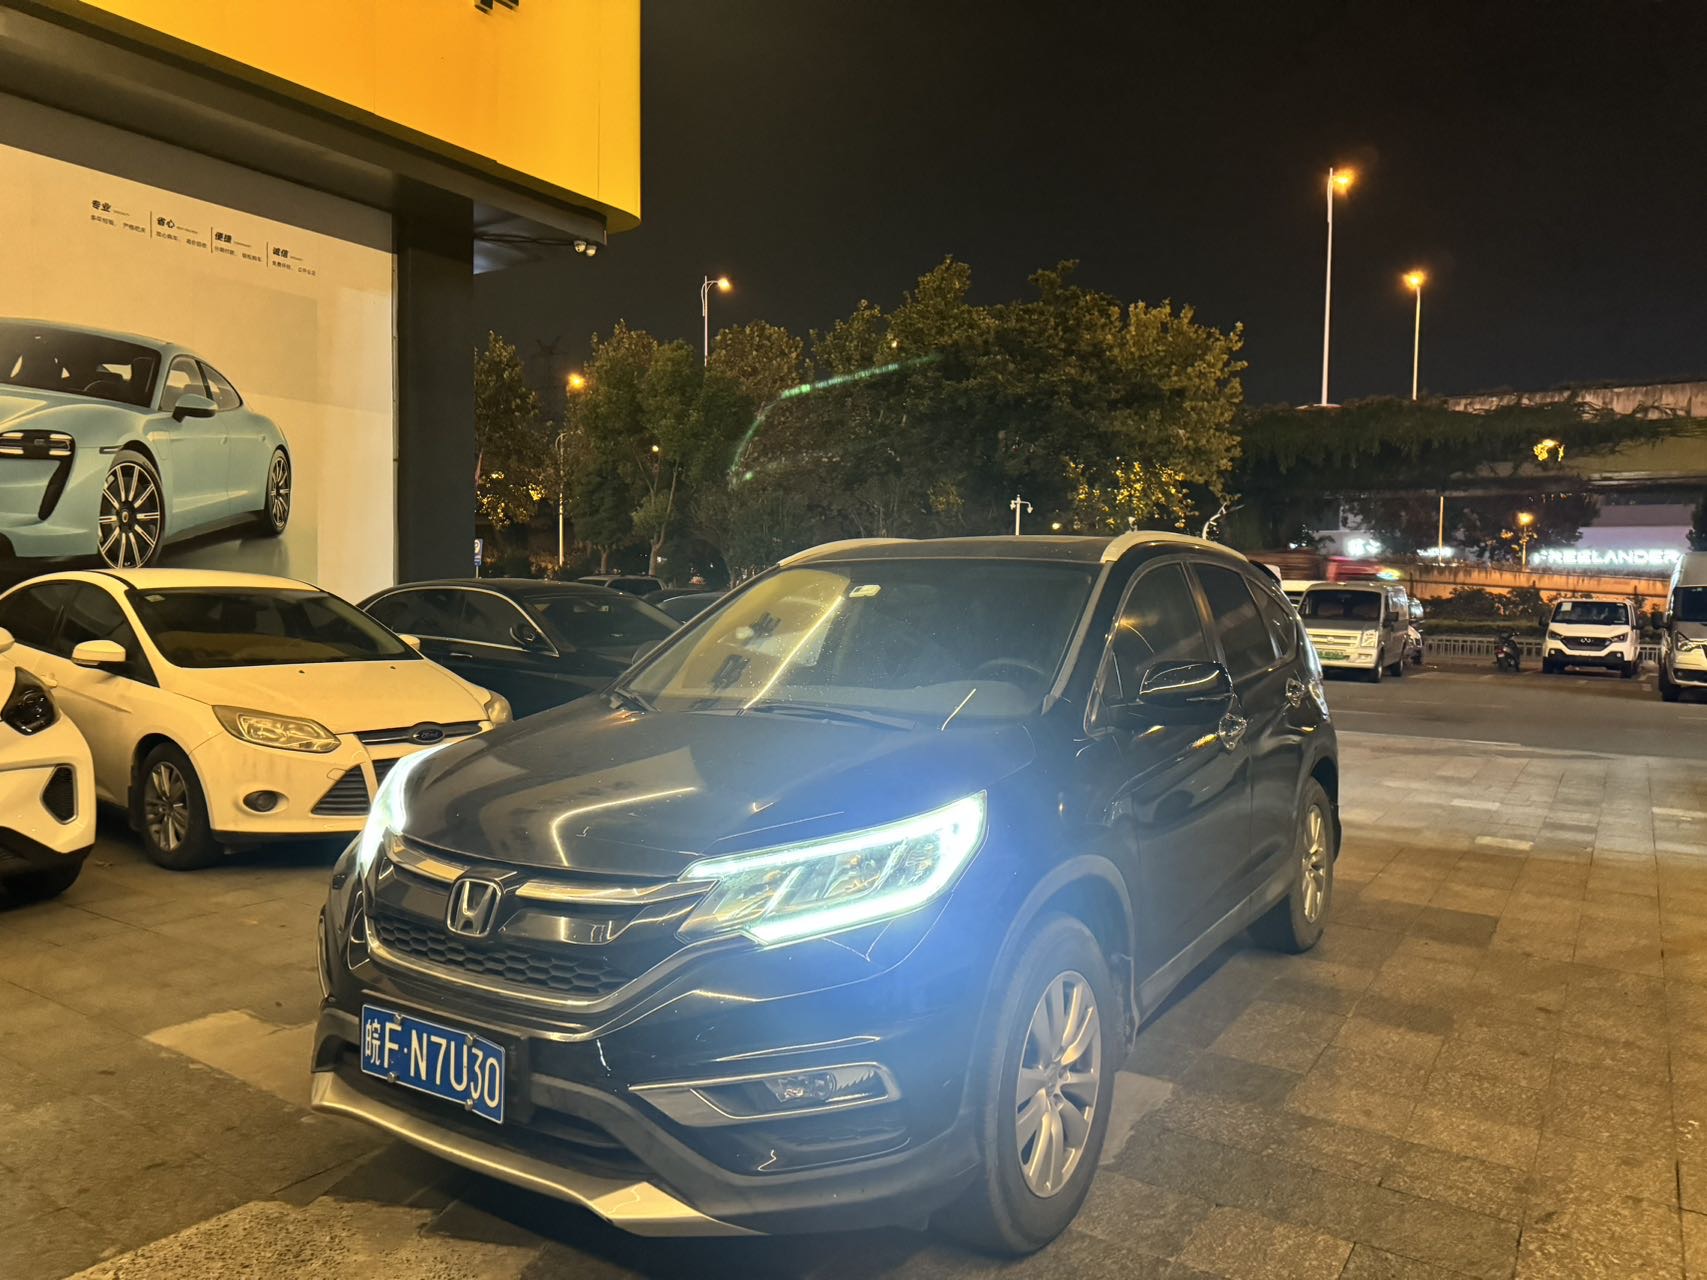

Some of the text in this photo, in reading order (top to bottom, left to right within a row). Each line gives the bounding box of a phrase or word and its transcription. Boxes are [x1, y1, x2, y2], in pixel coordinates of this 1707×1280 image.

[92, 200, 111, 212] 专业
[157, 217, 175, 228] 省心
[272, 247, 288, 258] 诚信
